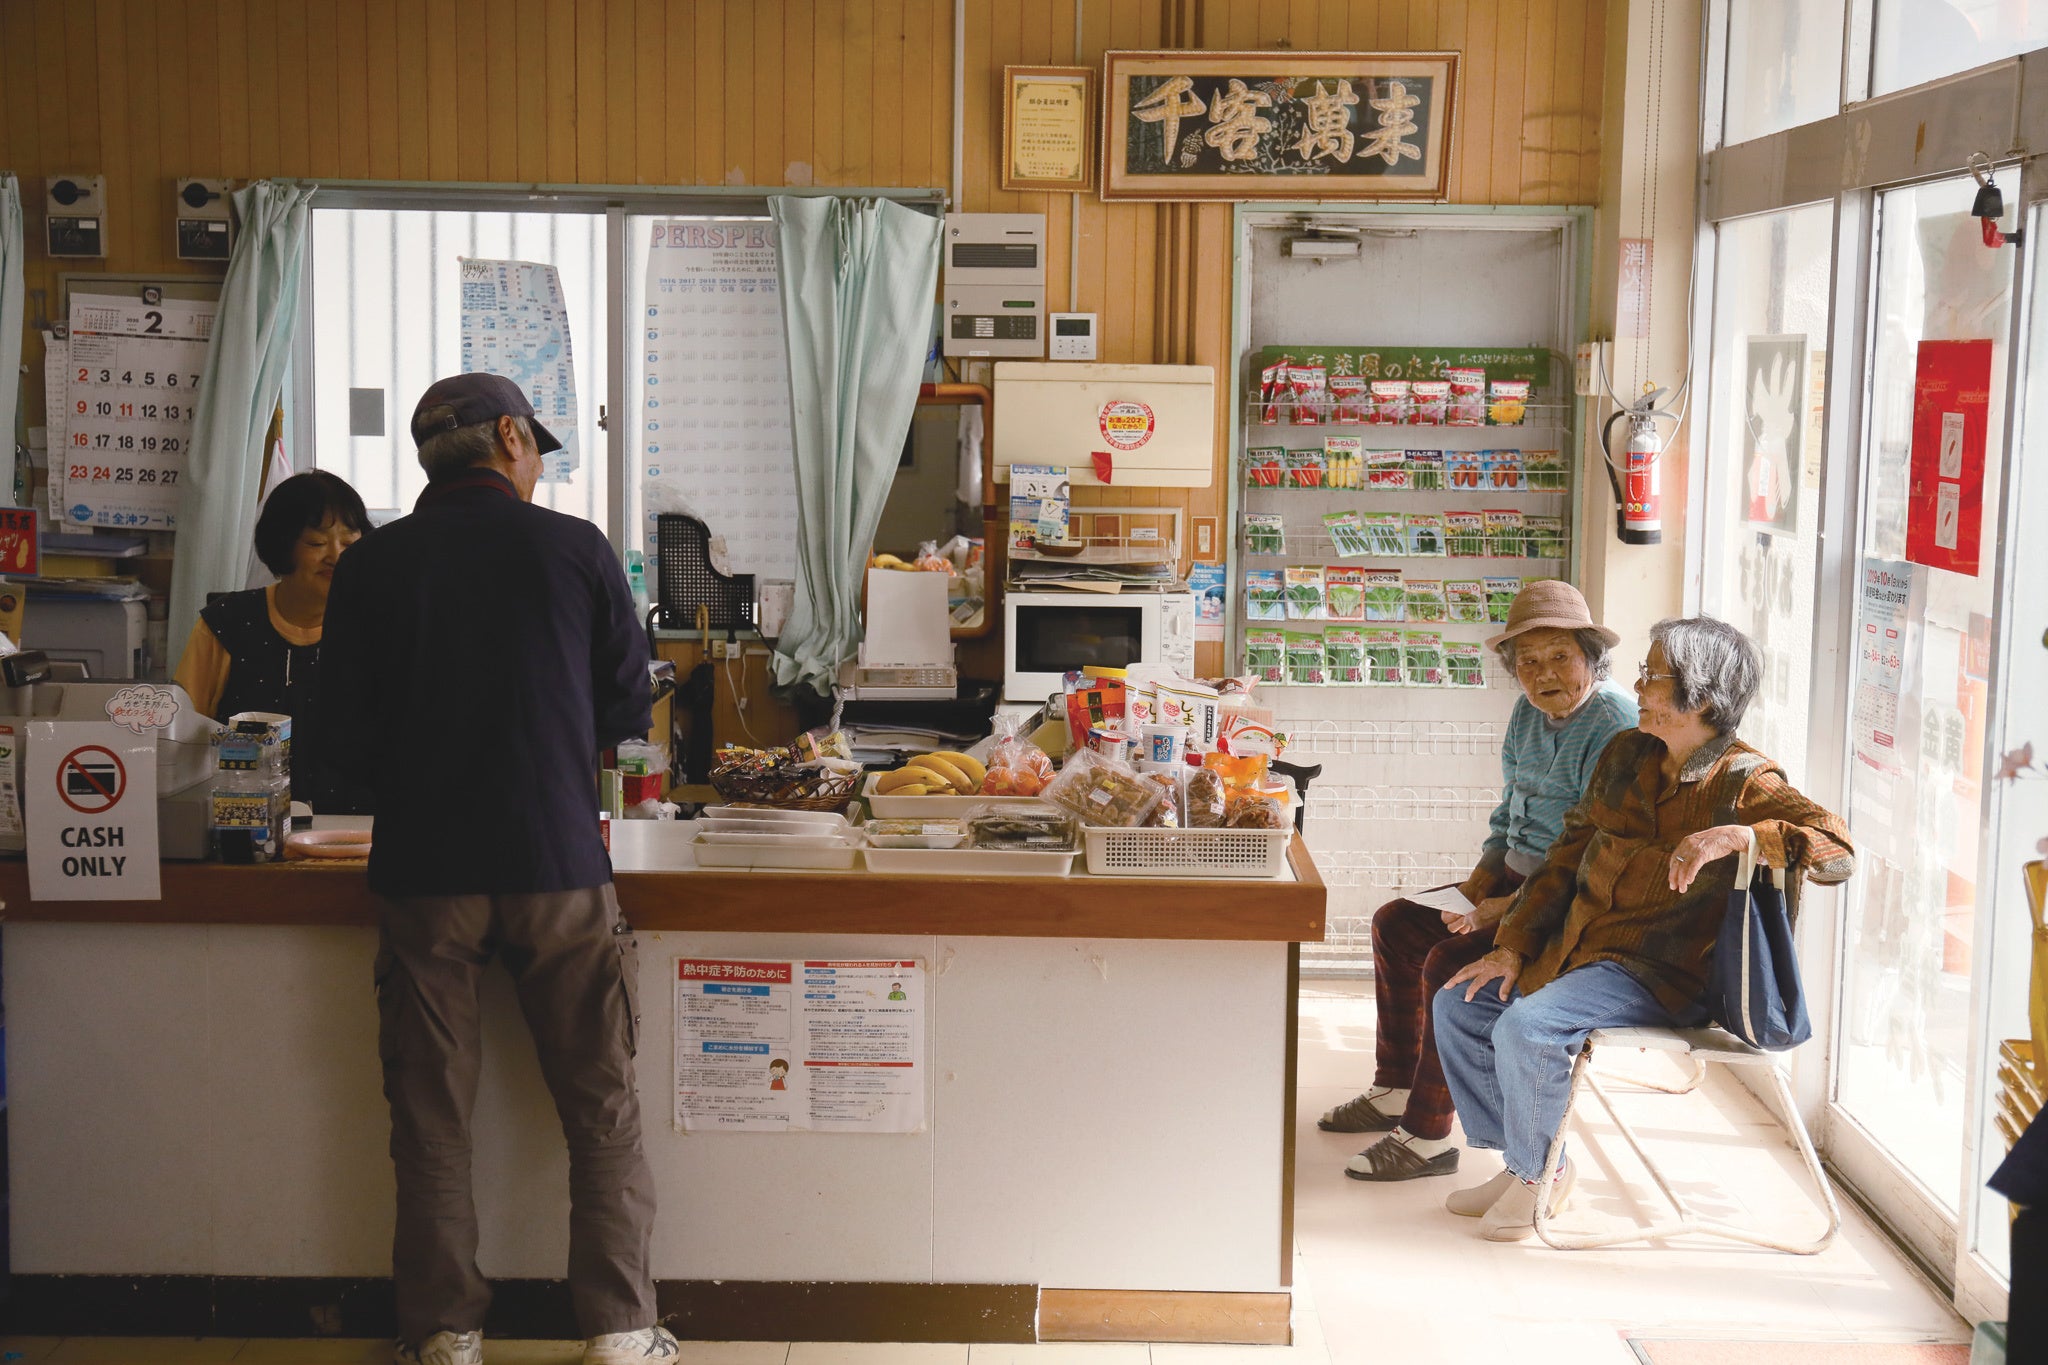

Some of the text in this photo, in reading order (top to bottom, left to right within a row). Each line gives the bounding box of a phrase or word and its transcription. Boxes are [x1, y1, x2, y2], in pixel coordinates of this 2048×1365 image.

[1622, 243, 1646, 312] 消火器
[144, 311, 163, 333] 2
[78, 368, 200, 388] 2 3 4 5 6 7
[77, 401, 196, 420] 9 10 11 12 13 1
[73, 433, 179, 451] 16 17 18 19 20
[70, 465, 178, 483] 23 24 25 26 27
[113, 512, 176, 526] 全沖フード
[1180, 700, 1195, 725] しょ
[61, 827, 124, 847] CASH
[62, 856, 126, 876] ONLY
[683, 963, 787, 979] 熱中症予防のために
